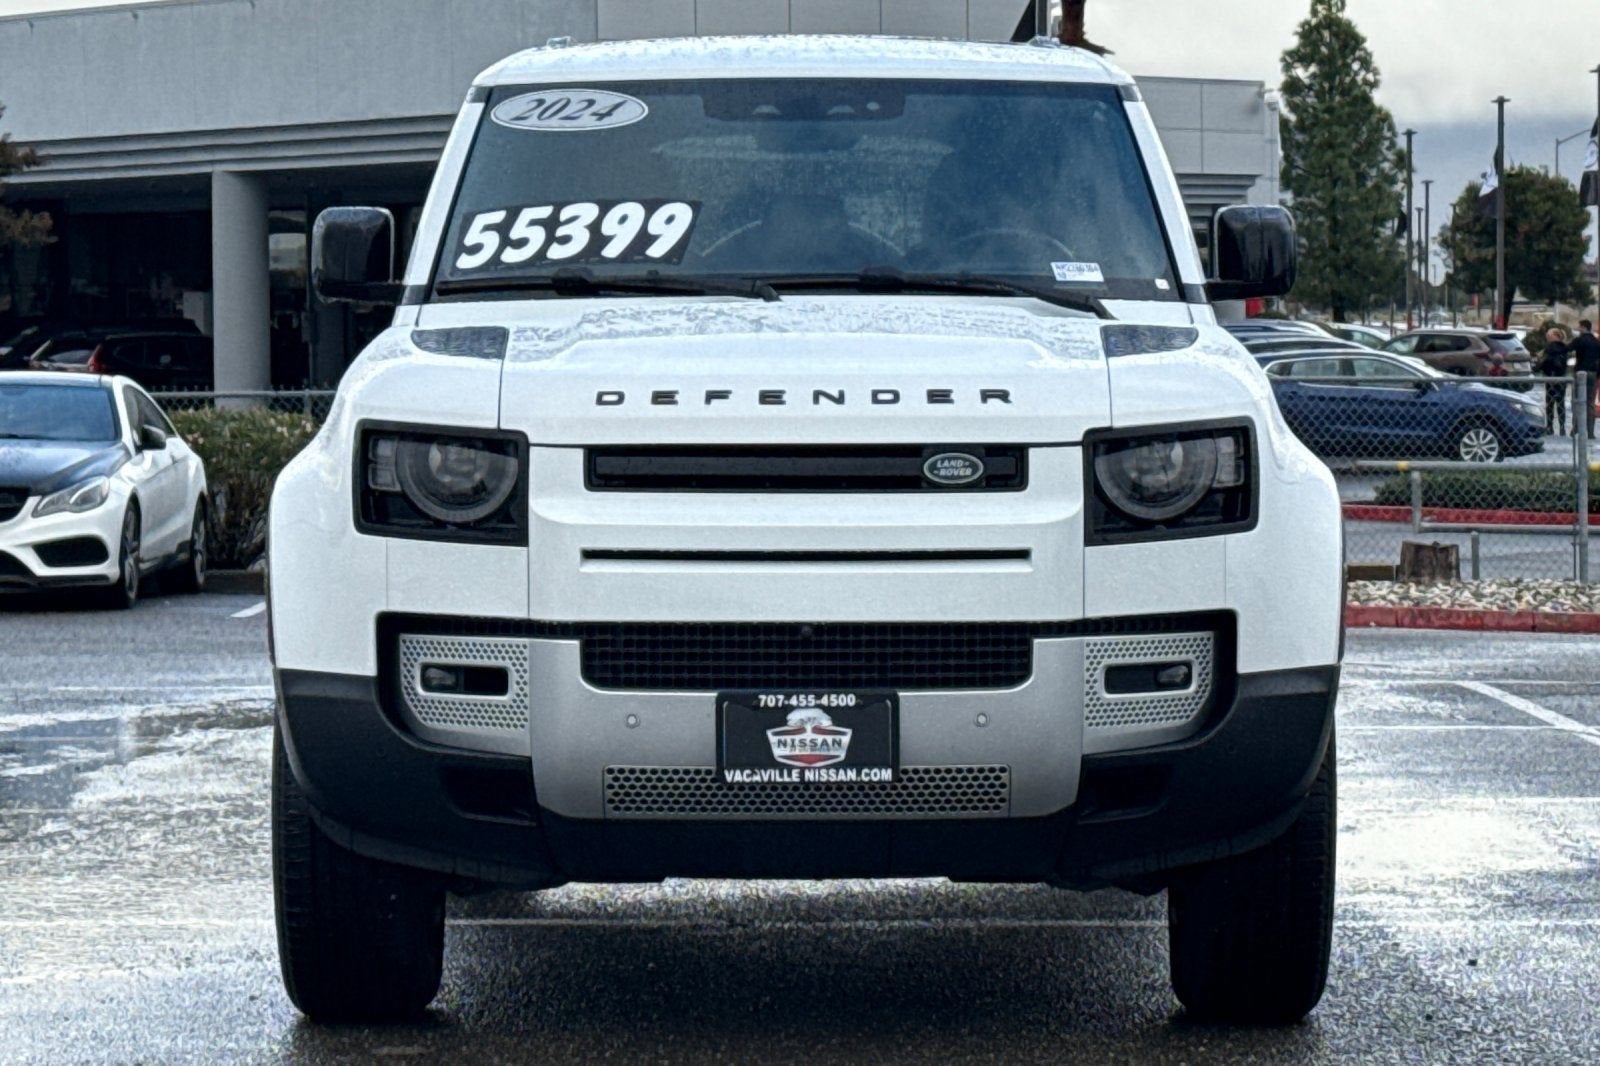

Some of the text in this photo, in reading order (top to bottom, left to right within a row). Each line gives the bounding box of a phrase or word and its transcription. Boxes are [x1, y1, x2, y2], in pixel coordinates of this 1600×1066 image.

[510, 97, 628, 122] 2024
[455, 201, 693, 269] 55399
[595, 389, 1013, 406] DEFENDER
[758, 694, 856, 707] 707-455-4500
[777, 738, 842, 749] NISSAN
[804, 768, 892, 782] NISSAN.COM
